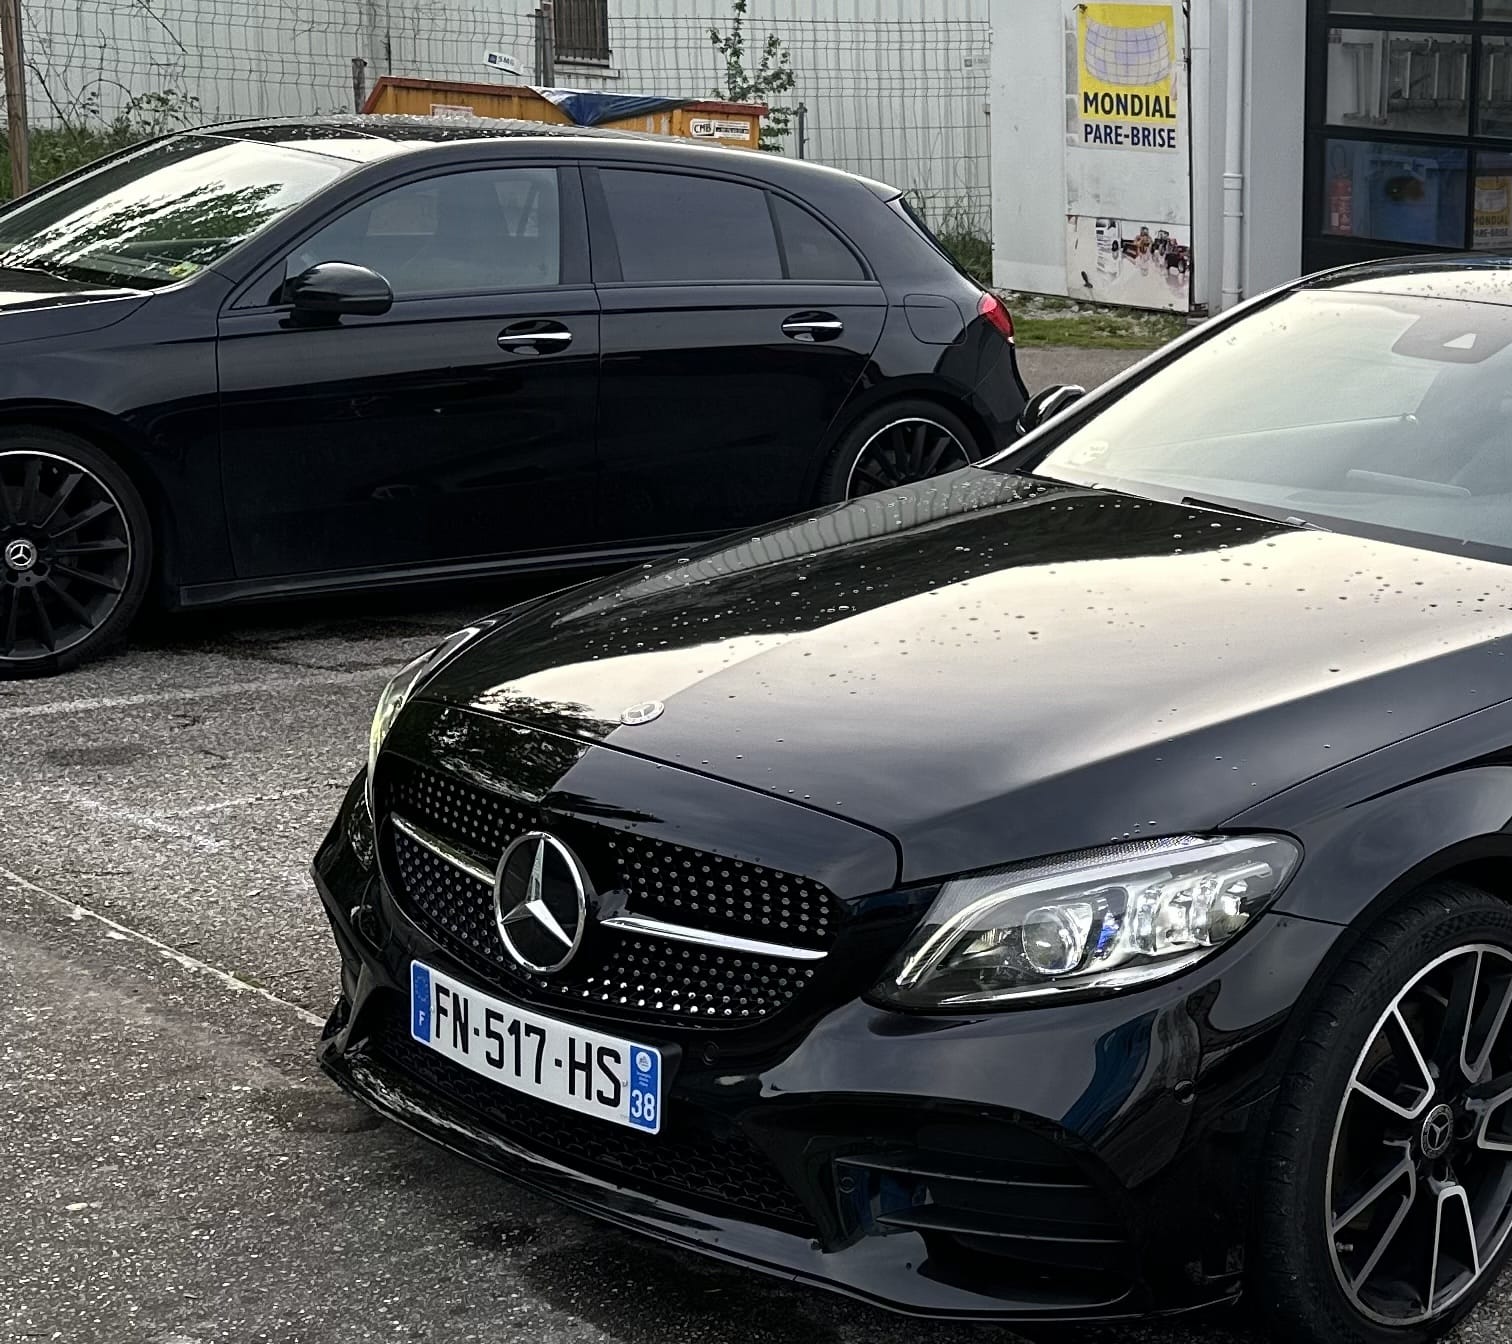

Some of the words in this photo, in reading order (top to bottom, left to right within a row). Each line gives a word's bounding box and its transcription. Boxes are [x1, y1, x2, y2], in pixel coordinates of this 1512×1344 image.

[1083, 91, 1177, 119] MONDIAL
[1083, 123, 1177, 149] PARE-BRISE
[417, 1009, 426, 1027] F
[434, 982, 622, 1109] FN-517-HS
[631, 1089, 656, 1122] 38
